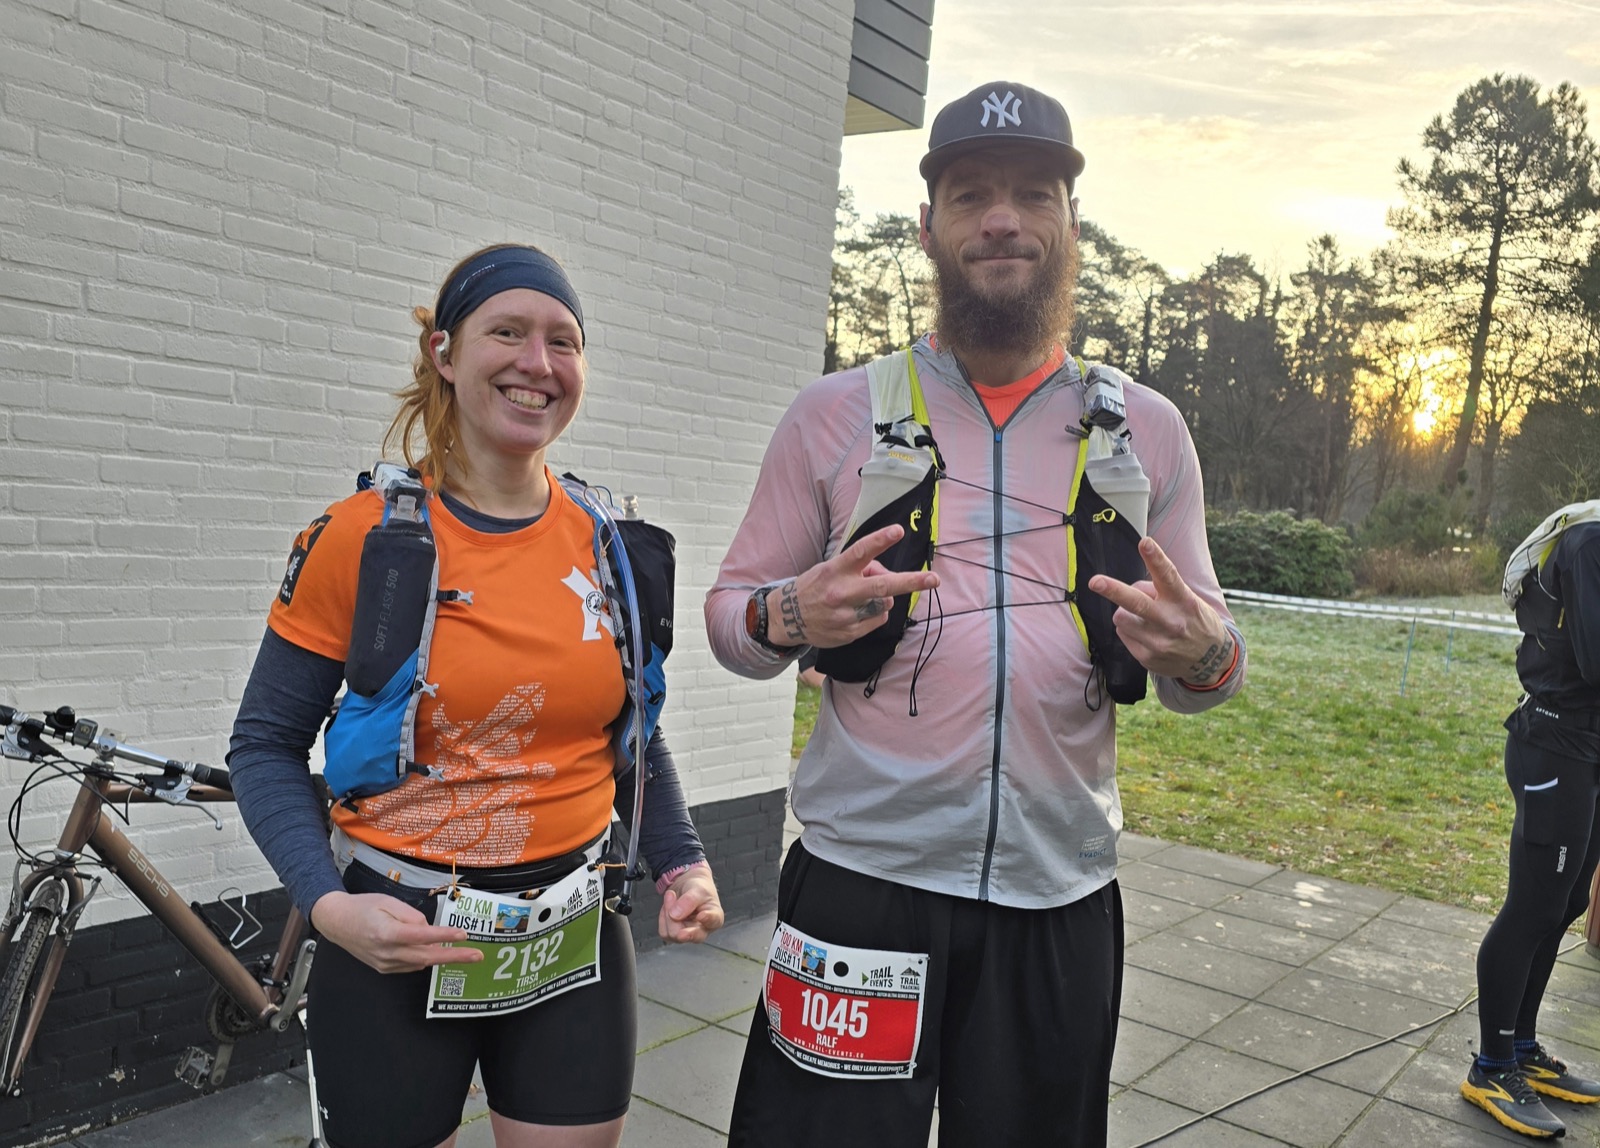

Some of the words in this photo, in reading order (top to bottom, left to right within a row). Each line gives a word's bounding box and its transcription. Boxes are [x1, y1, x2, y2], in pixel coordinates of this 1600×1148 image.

[980, 90, 1022, 128] NY
[386, 568, 399, 589] 500
[380, 588, 394, 622] FLASK
[374, 623, 389, 652] SOFT
[456, 896, 472, 911] 50
[474, 898, 493, 916] KM
[567, 887, 582, 908] TRAIL
[448, 913, 493, 934] DUS#11
[781, 930, 792, 947] 100
[791, 936, 803, 954] KM
[494, 930, 564, 980] 2132
[774, 946, 800, 970] DUS#11
[516, 972, 538, 988] TIRSA
[870, 966, 894, 980] TRAIL
[870, 978, 894, 988] EVENTS
[900, 976, 920, 986] TRAIL
[500, 999, 517, 1008] CREATE
[802, 988, 869, 1039] 1045
[816, 1032, 838, 1048] RALF
